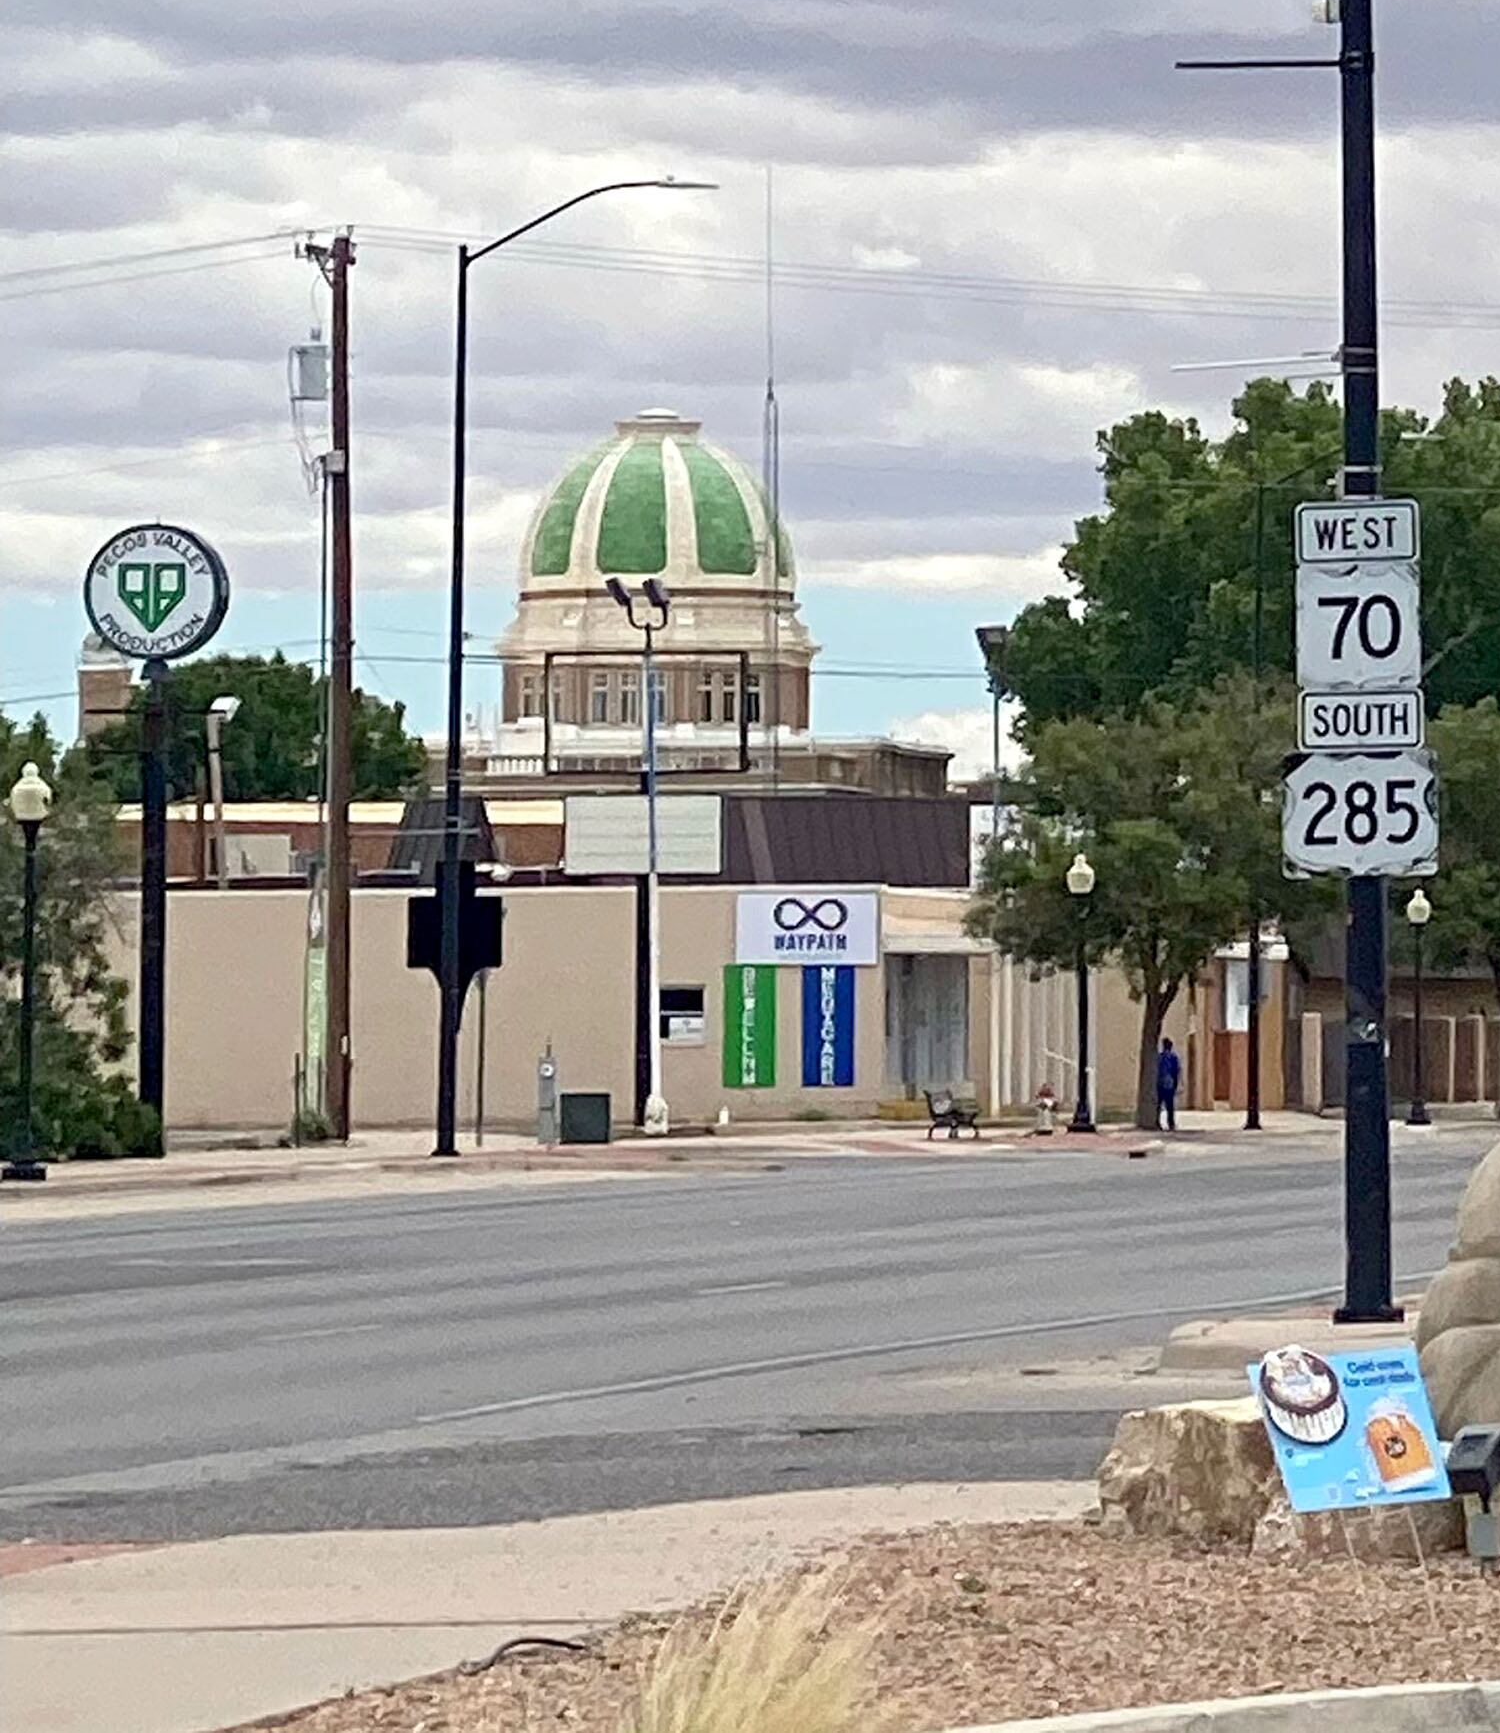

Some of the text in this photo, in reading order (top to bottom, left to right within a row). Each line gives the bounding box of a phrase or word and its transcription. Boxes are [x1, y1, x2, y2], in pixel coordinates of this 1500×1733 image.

[1314, 517, 1397, 550] WEST
[96, 532, 210, 579] PECOS VALLEY
[99, 613, 204, 652] PRODUCTION
[1317, 594, 1400, 660] 70
[1313, 703, 1409, 737] SOUTH
[1301, 779, 1419, 847] 285
